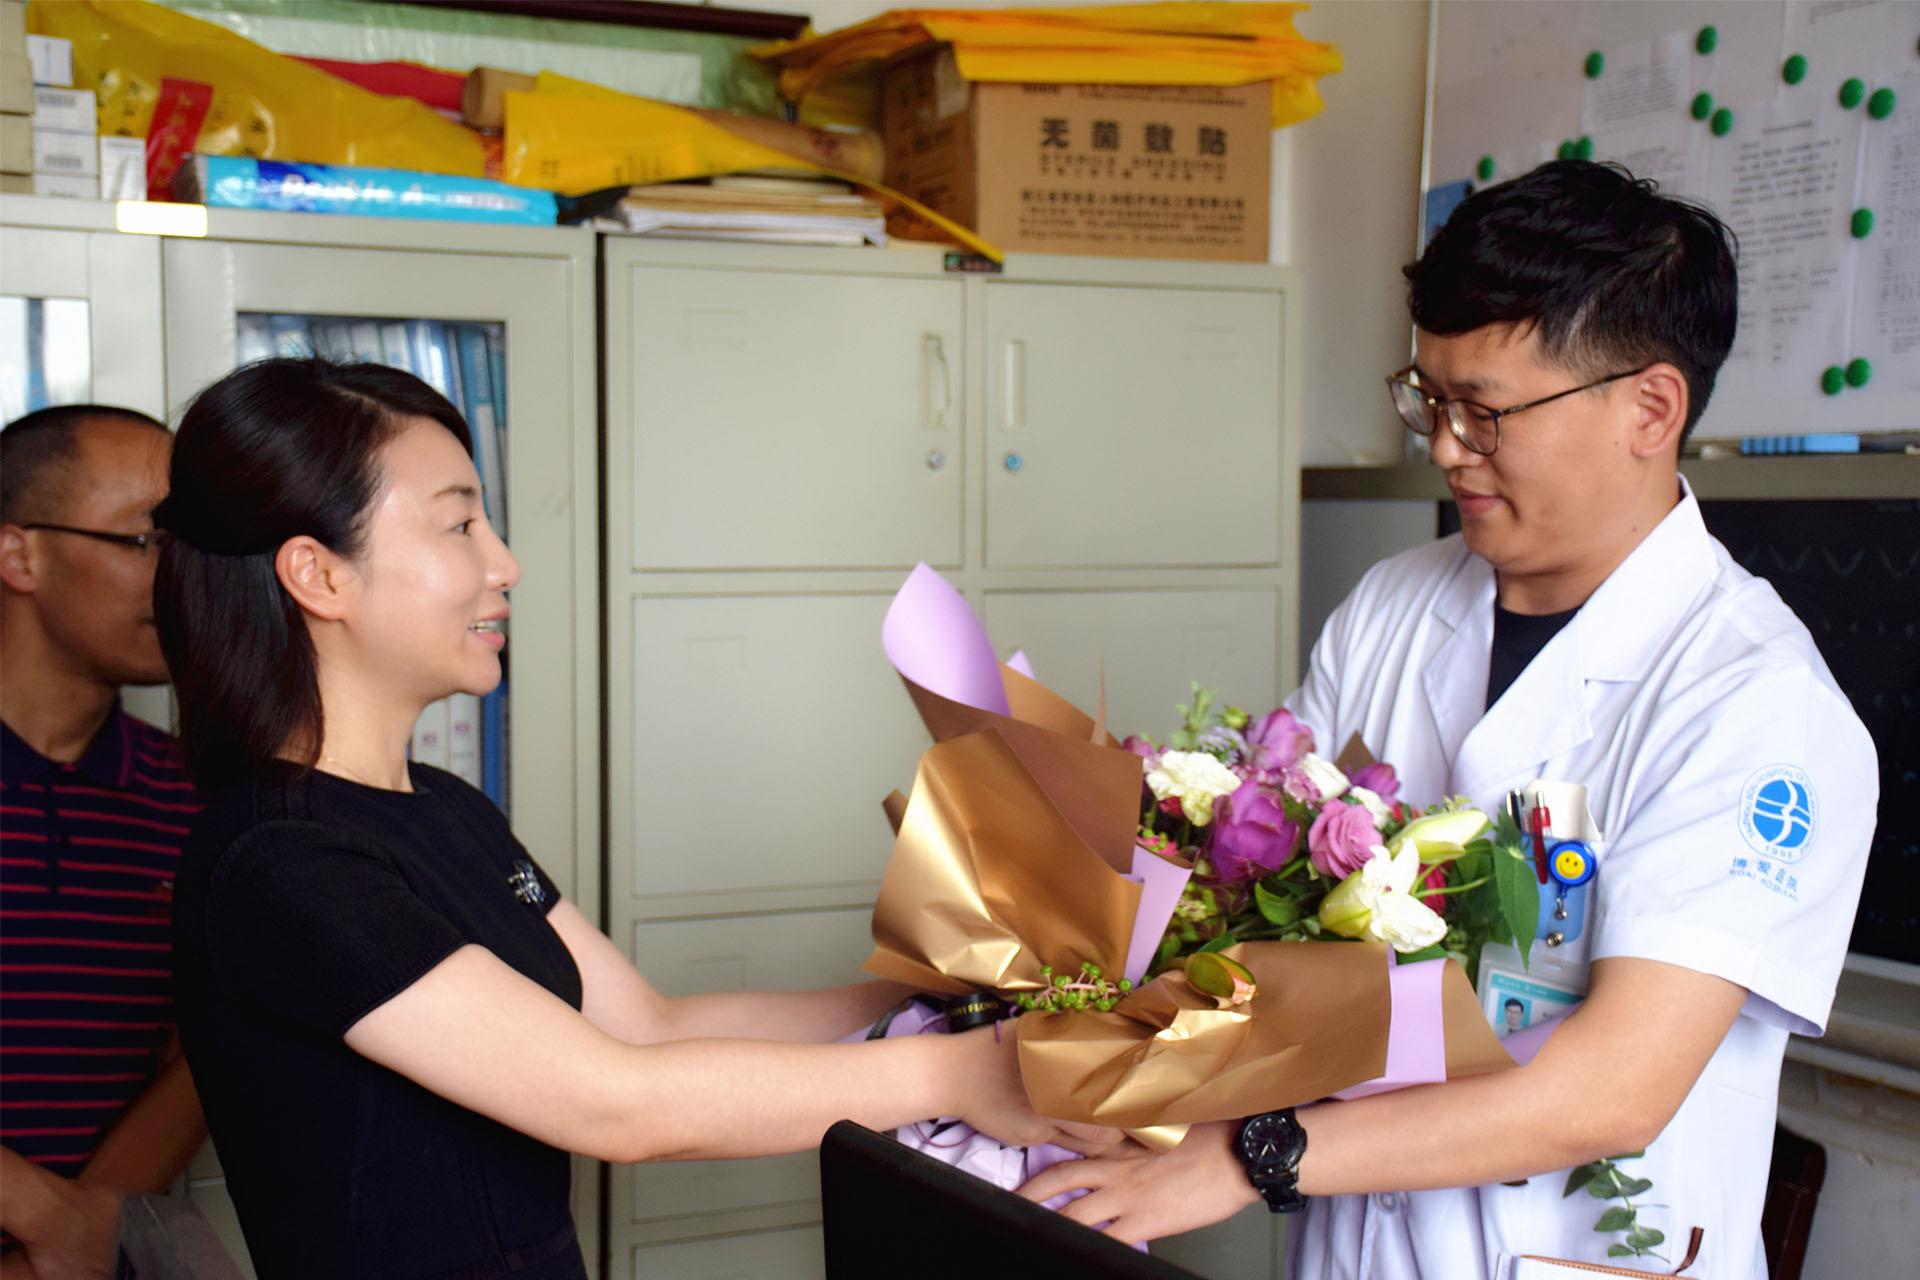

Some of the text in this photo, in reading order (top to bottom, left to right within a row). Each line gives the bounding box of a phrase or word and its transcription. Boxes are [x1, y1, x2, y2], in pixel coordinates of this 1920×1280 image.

[1040, 117, 1228, 156] 无菌敷贴
[1729, 868, 1800, 902] BOAI HOSPITAL
